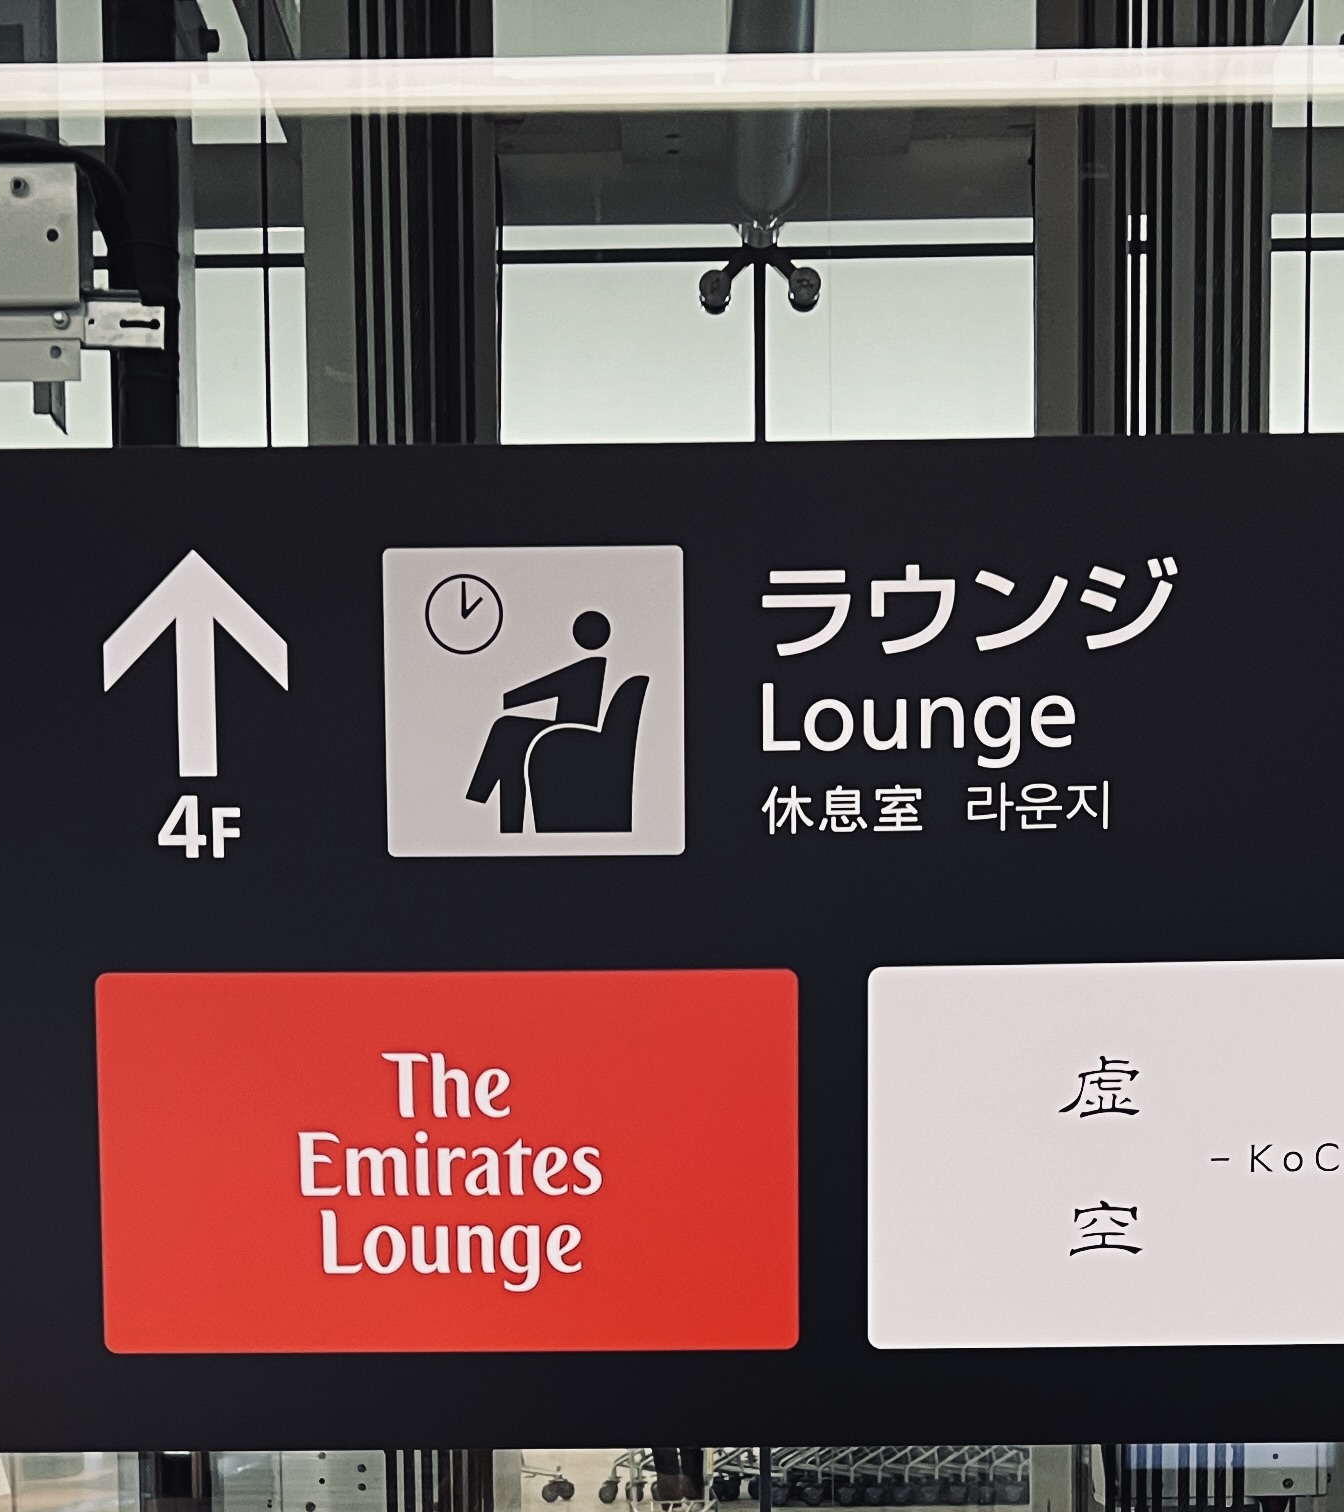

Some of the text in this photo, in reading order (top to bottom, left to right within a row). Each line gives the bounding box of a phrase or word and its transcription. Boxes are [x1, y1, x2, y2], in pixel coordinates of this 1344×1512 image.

[761, 556, 1179, 658] ラウンジ
[762, 682, 1077, 770] Lounge
[157, 795, 242, 860] 4F
[762, 784, 924, 836] 休息室
[967, 780, 1109, 832] 라운지
[381, 1052, 512, 1119] The
[298, 1130, 603, 1198] Emirates
[320, 1209, 583, 1292] Lounge
